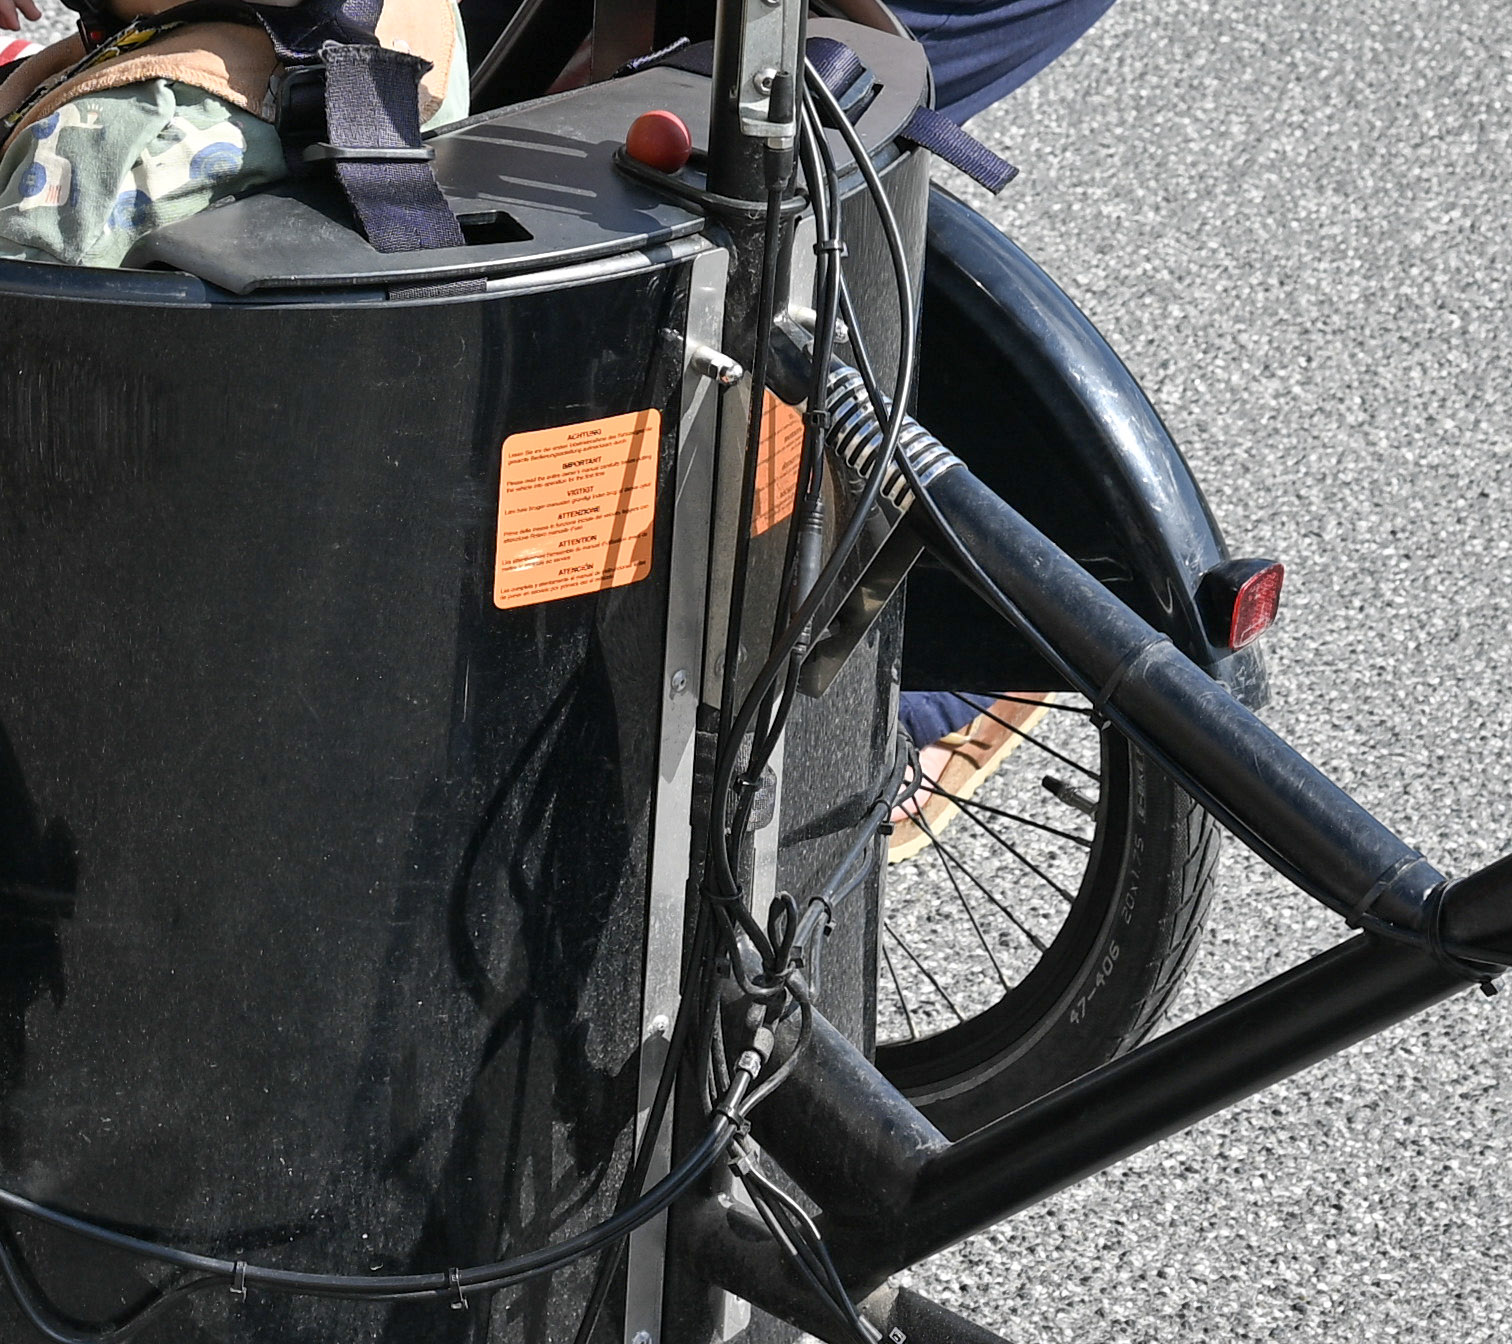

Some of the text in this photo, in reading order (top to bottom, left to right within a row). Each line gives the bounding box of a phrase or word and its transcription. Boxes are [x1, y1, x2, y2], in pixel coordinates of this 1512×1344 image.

[567, 428, 602, 440] ACHTUNG
[561, 455, 602, 469] IMPORTANT
[566, 485, 593, 496] VIGTIGT
[557, 505, 600, 520] ATTENZIONE
[557, 534, 597, 547] ATTENTION
